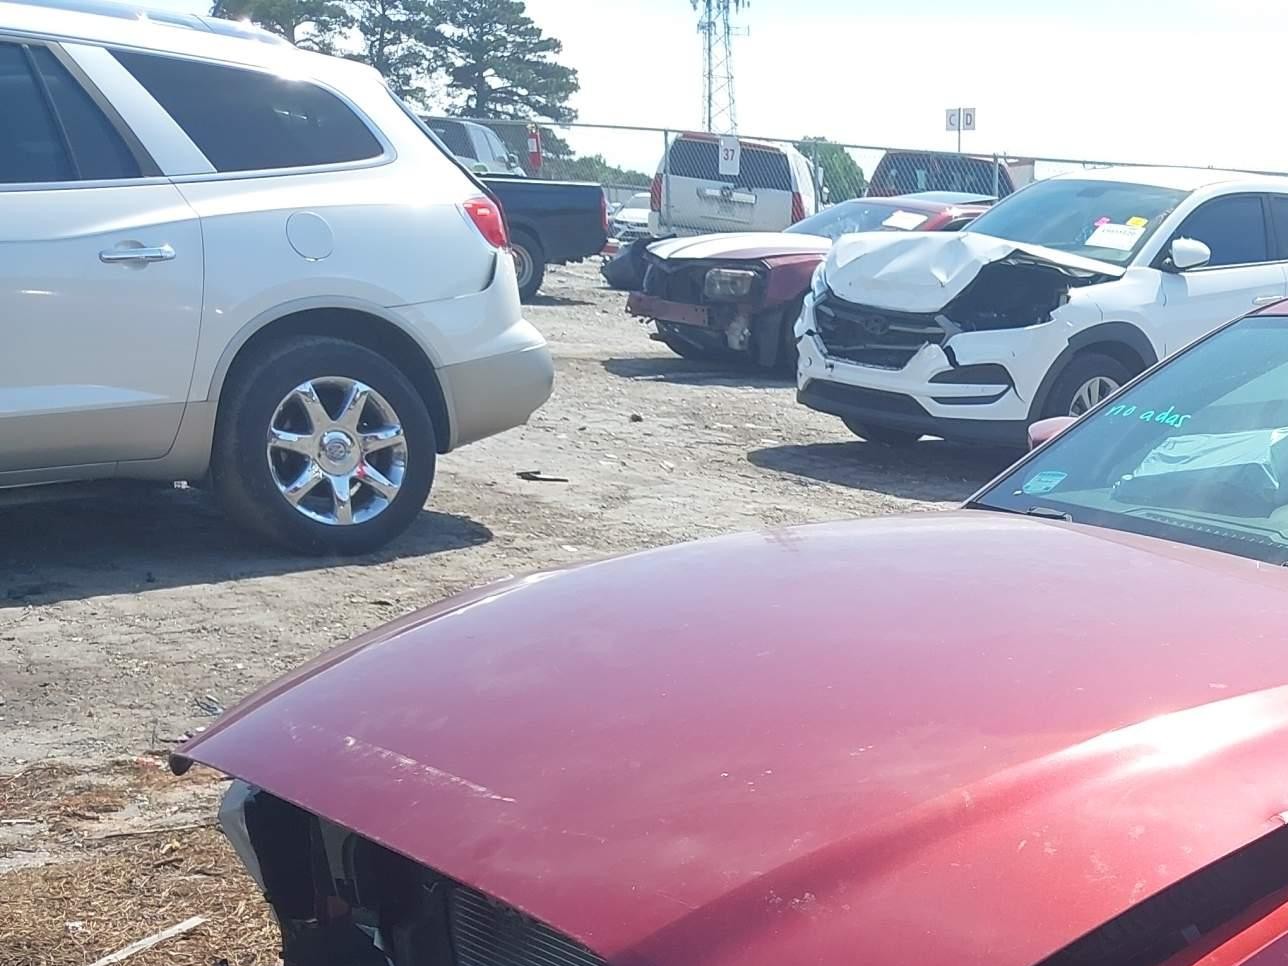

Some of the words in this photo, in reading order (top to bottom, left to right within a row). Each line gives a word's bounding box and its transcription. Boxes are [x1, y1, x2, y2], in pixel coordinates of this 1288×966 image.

[965, 112, 973, 126] D
[723, 148, 735, 161] 37
[1104, 404, 1137, 417] no
[1139, 405, 1192, 428] adas
